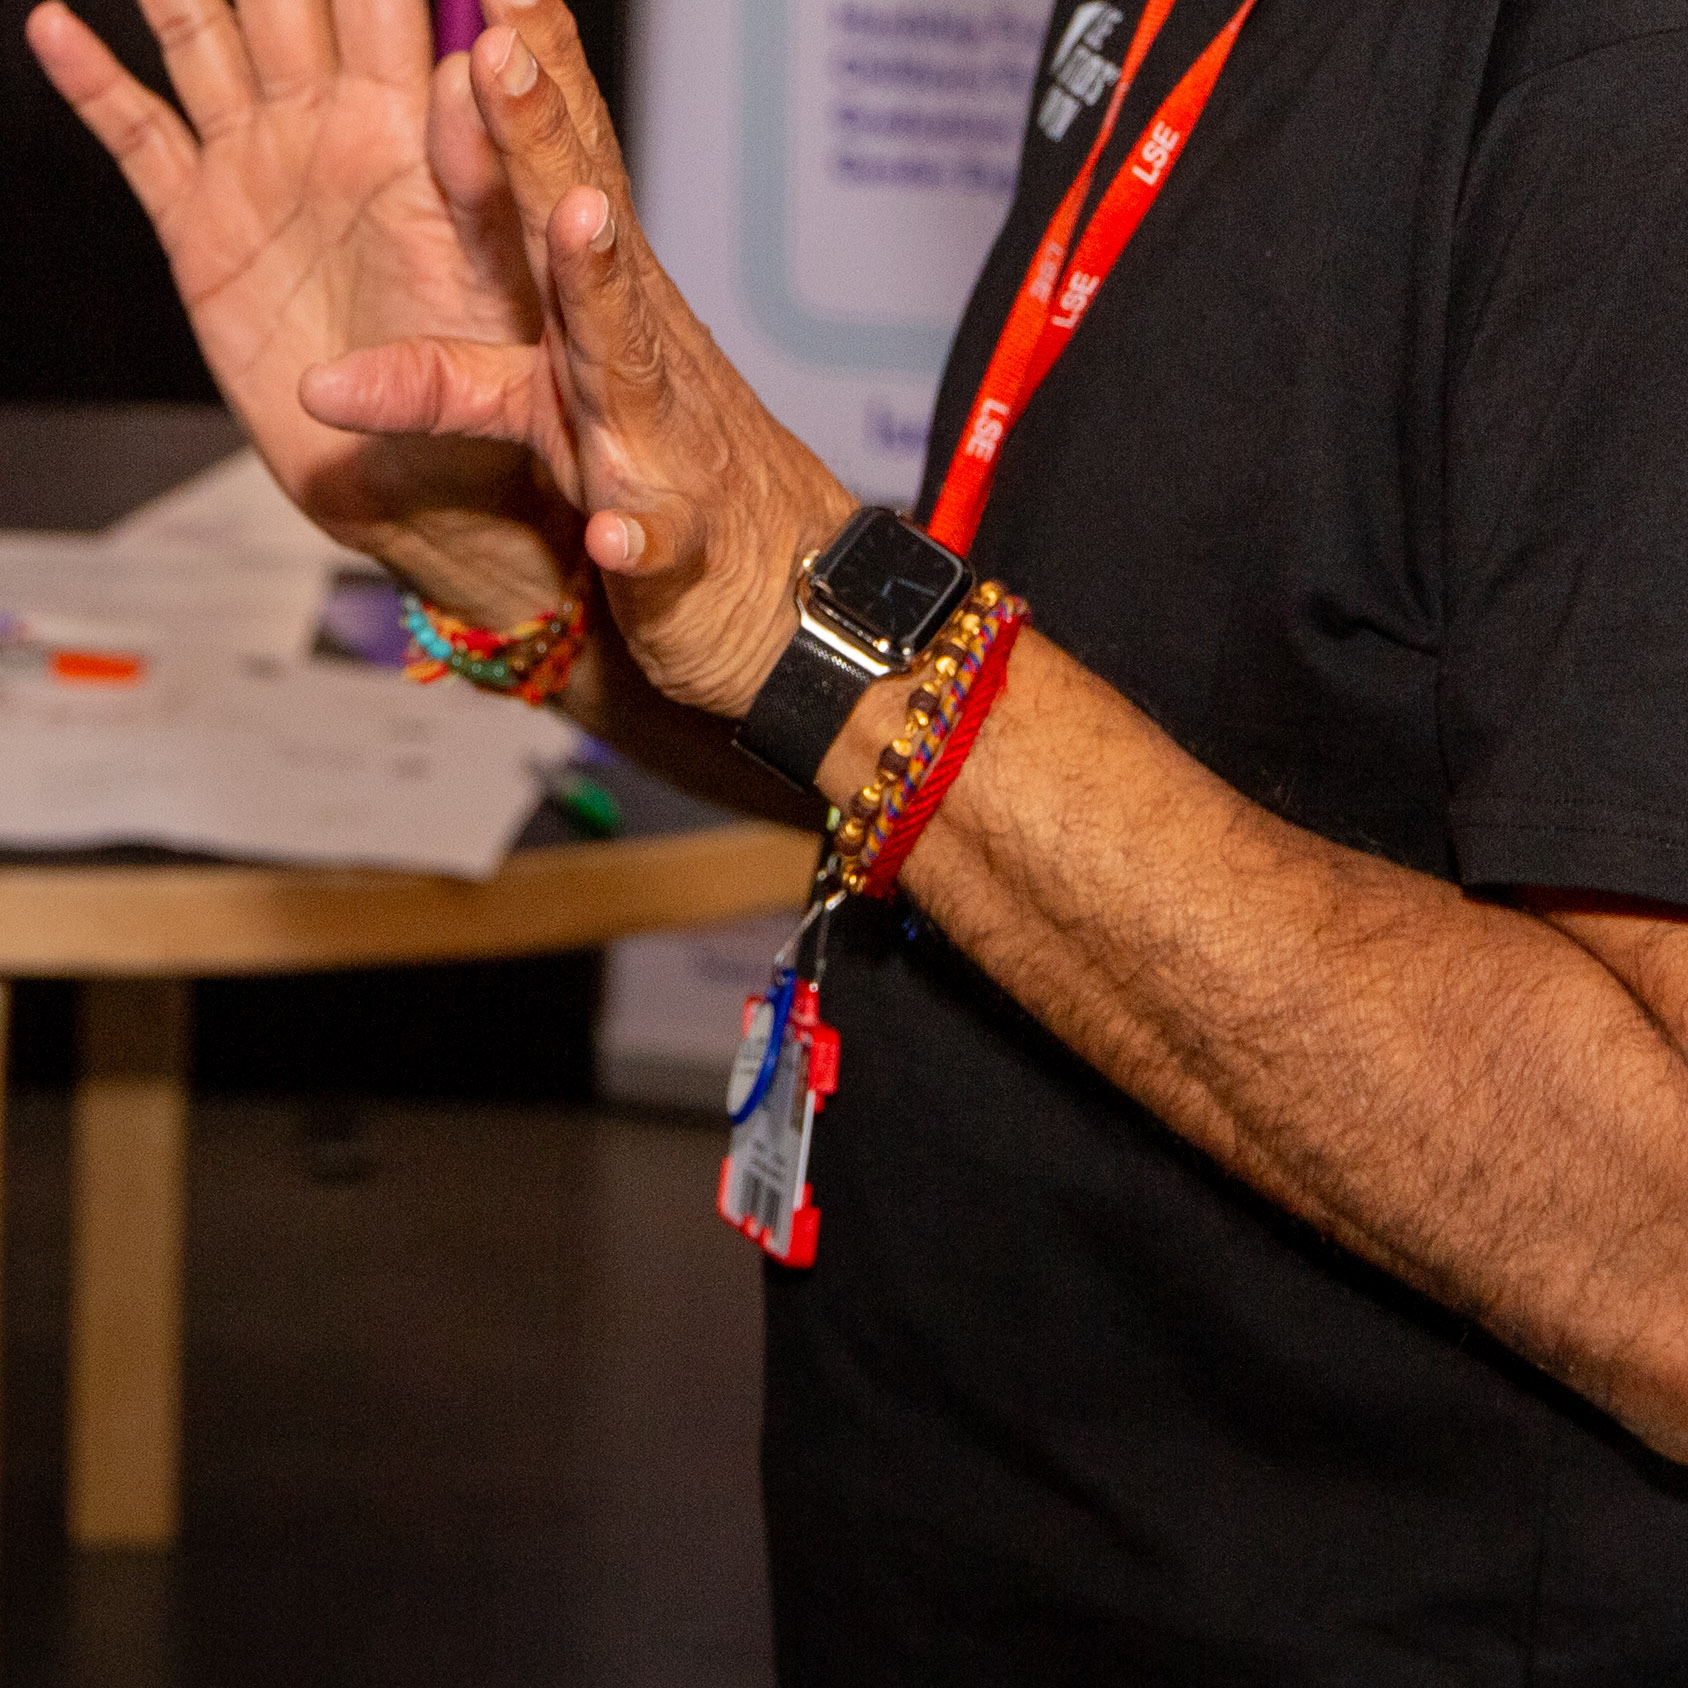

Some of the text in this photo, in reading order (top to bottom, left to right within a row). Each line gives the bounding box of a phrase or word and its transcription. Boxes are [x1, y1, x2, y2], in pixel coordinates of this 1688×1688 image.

[1132, 120, 1180, 186] LSE
[1052, 270, 1100, 329] LSE
[965, 397, 1012, 463] LSE
